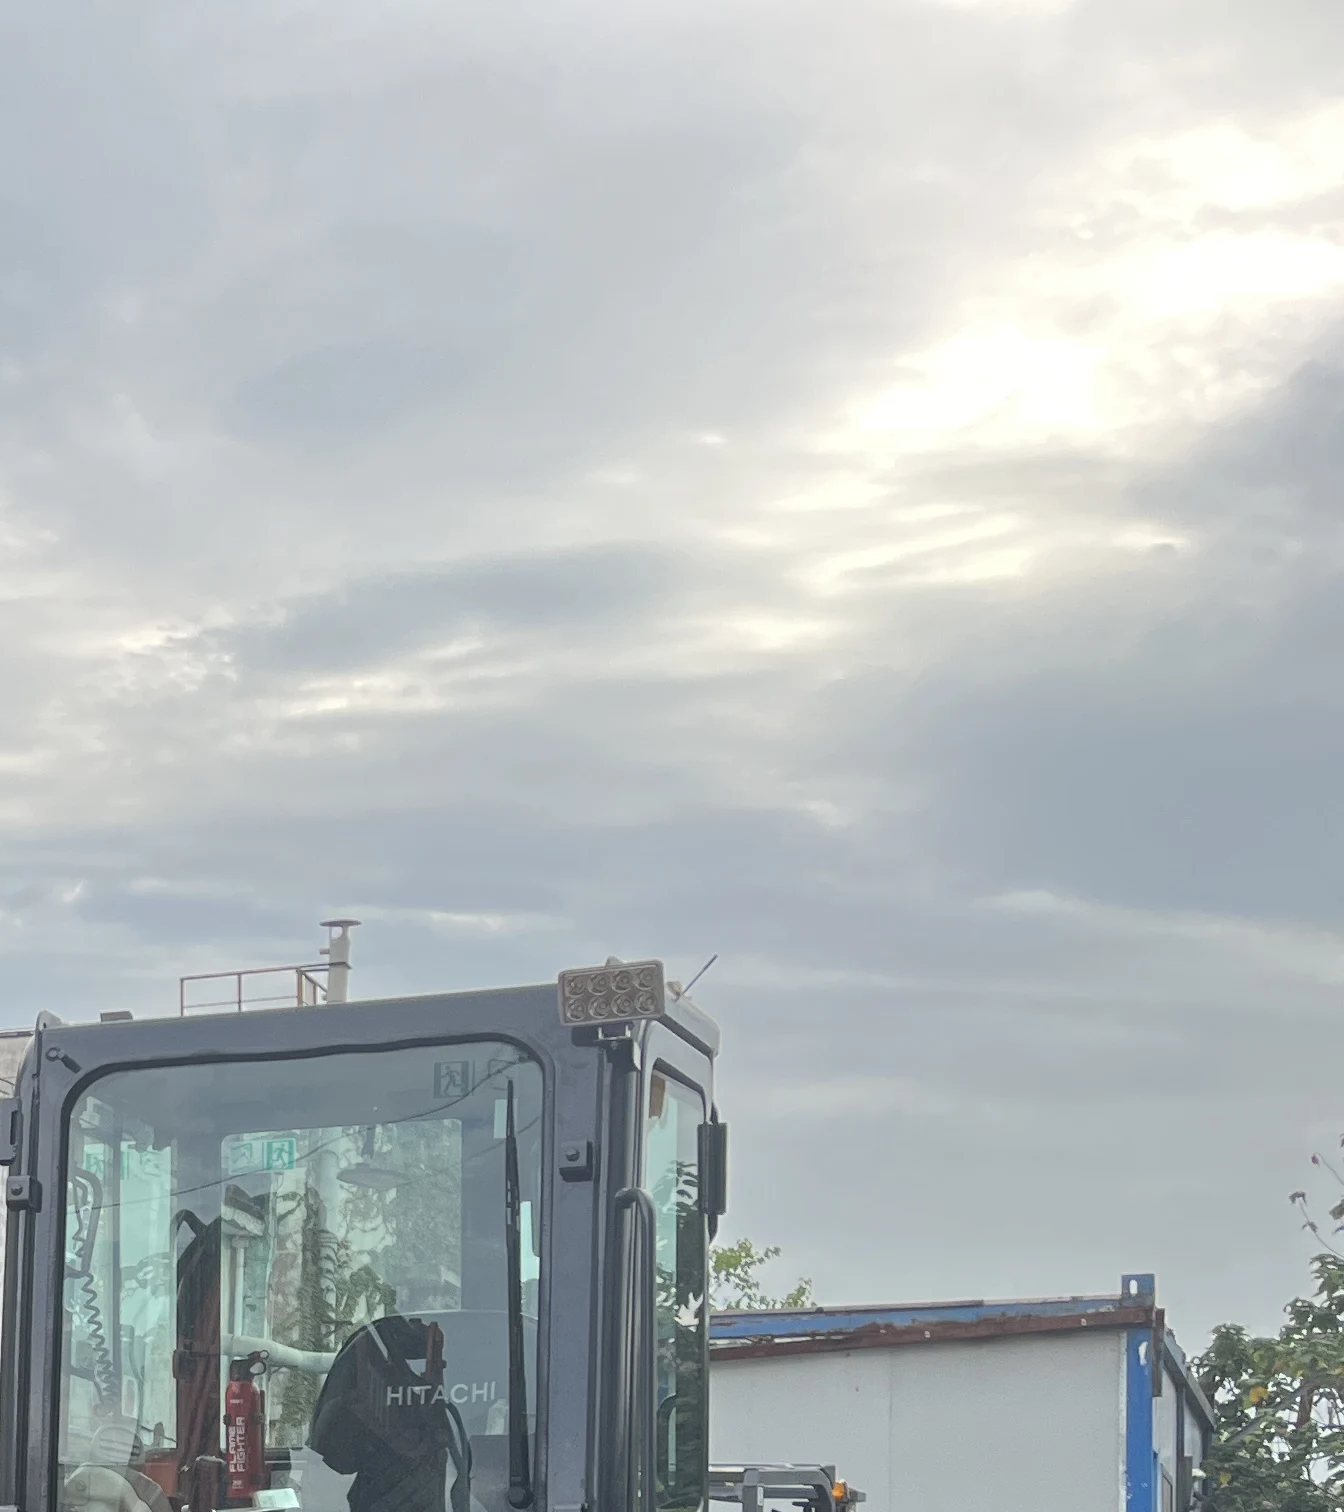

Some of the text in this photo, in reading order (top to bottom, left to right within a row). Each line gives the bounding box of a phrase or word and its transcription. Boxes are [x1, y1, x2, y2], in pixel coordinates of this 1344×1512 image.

[387, 1381, 496, 1406] HITACHI
[228, 1426, 236, 1472] FLAME
[236, 1417, 245, 1472] FIGHTER
